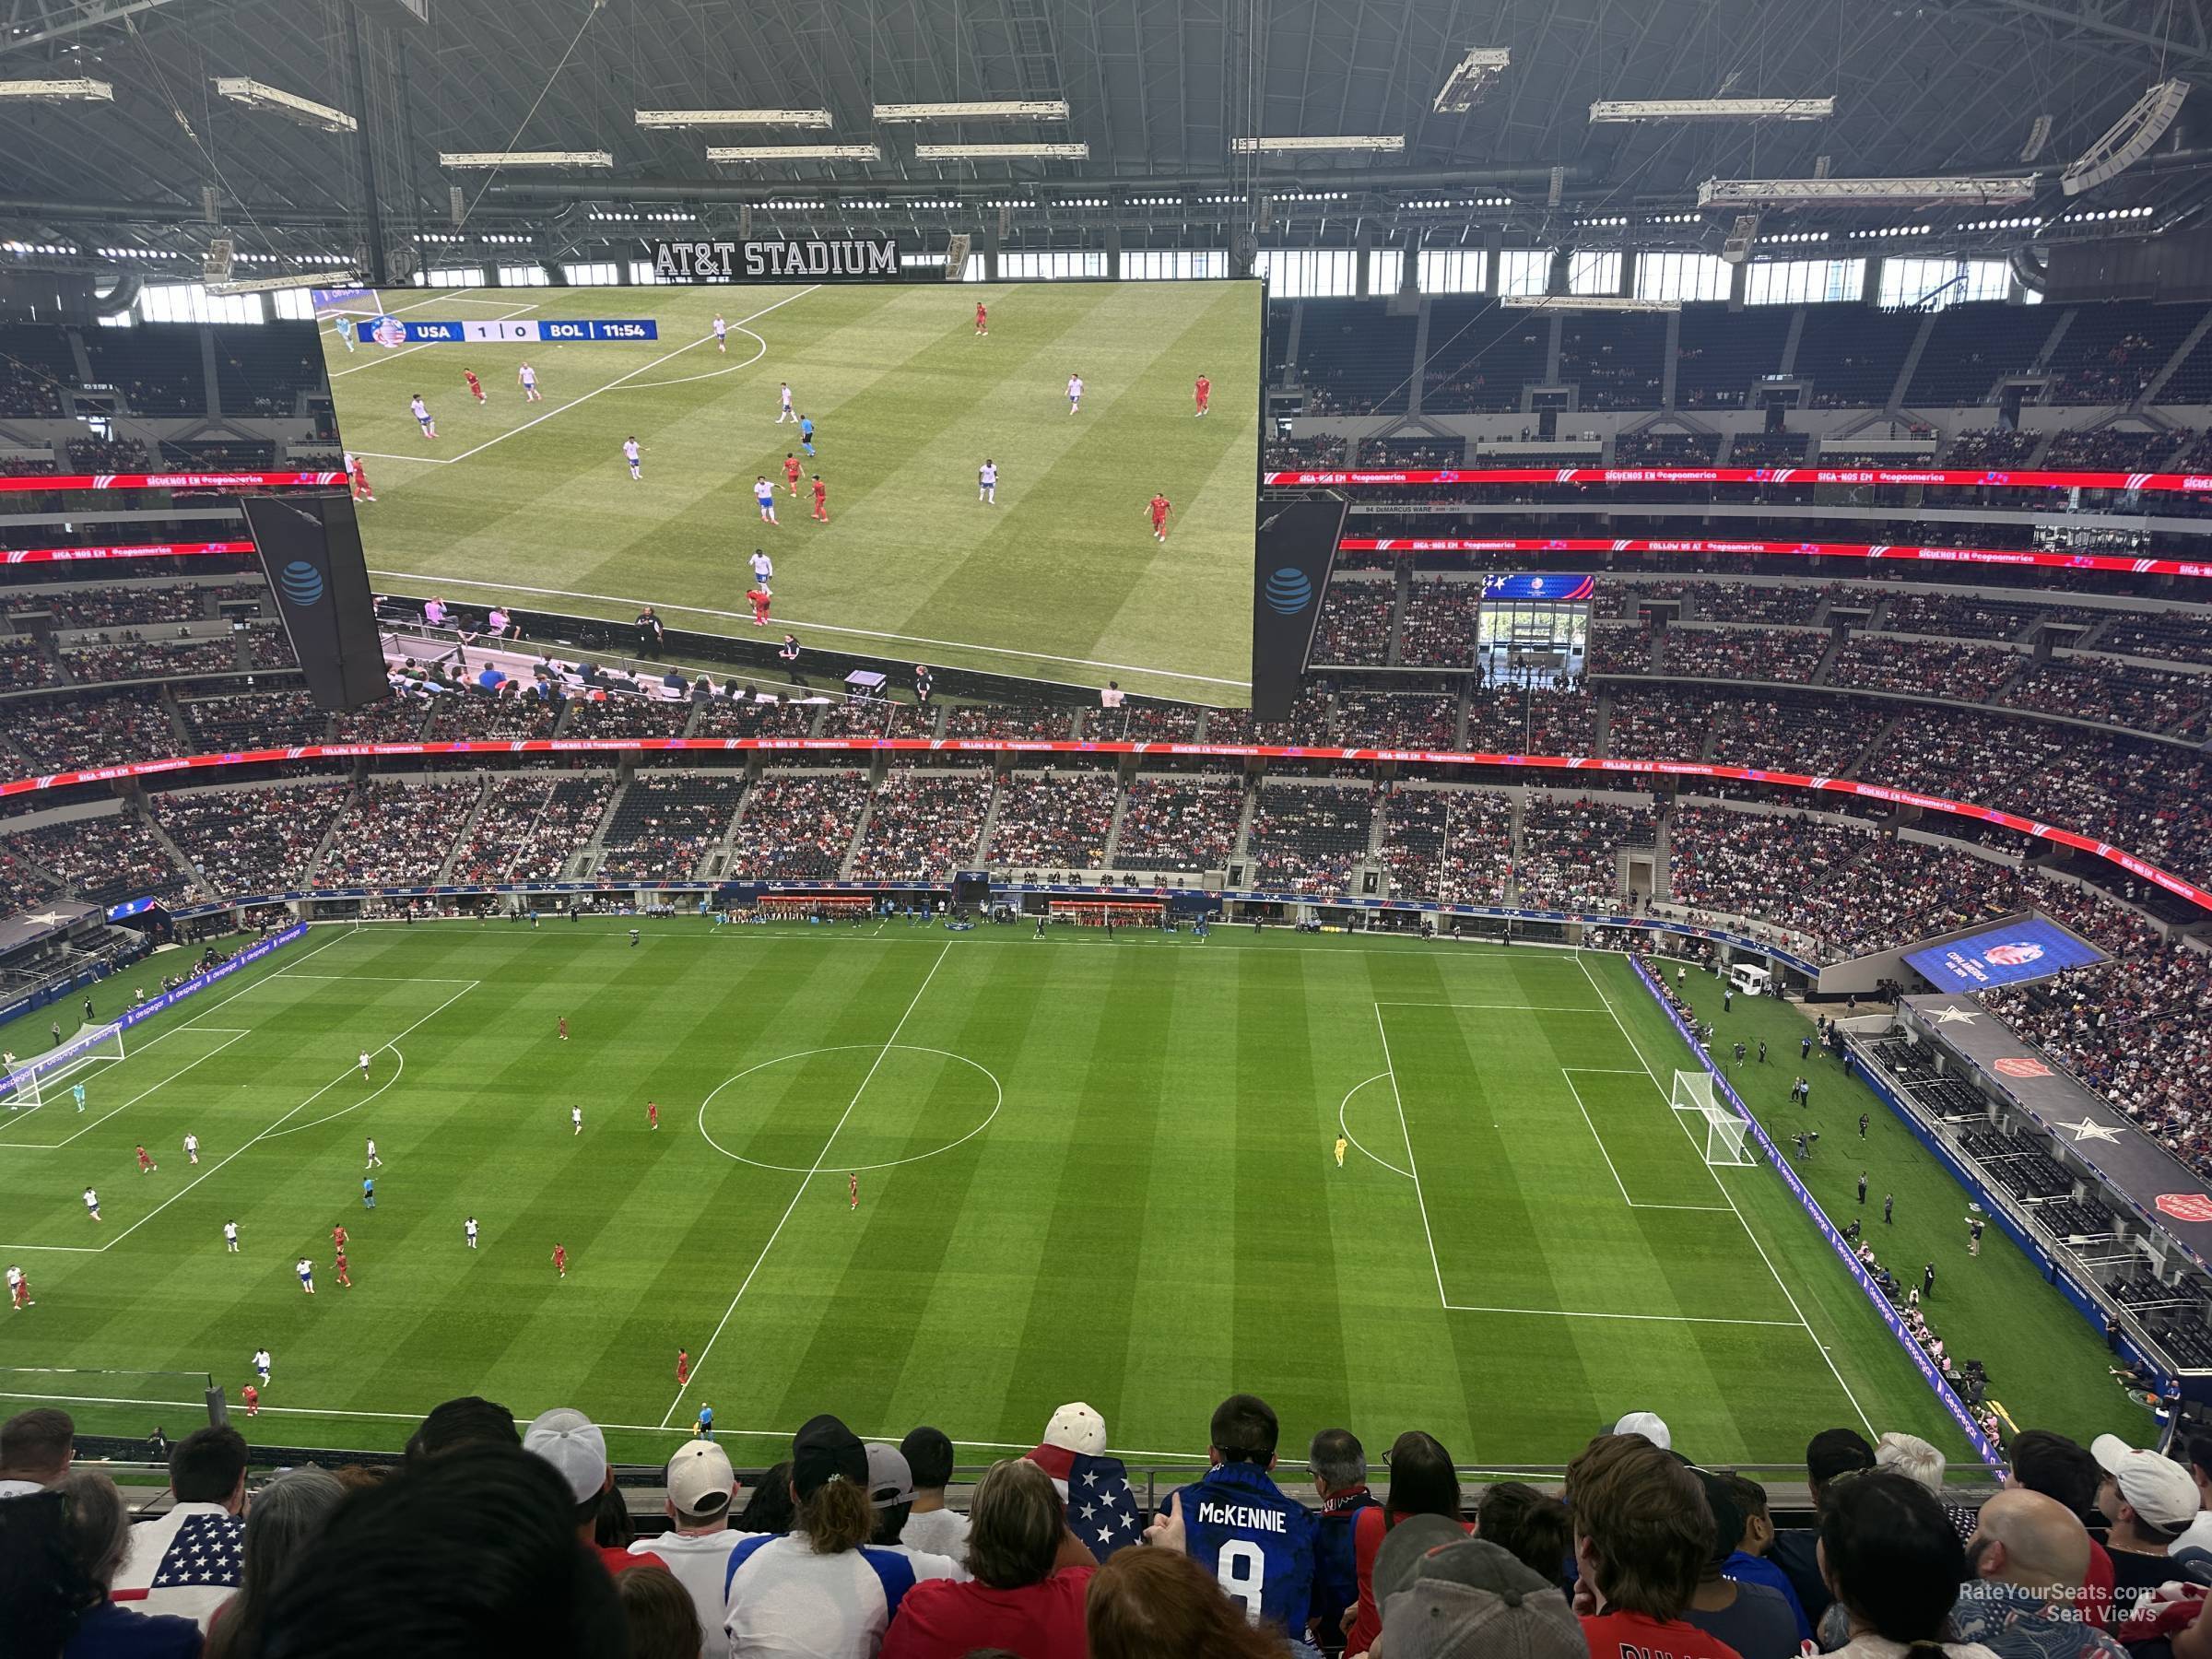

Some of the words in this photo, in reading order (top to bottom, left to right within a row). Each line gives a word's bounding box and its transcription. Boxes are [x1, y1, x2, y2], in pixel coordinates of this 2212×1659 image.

[655, 240, 735, 275] AT&T
[746, 239, 898, 276] STADIUM
[417, 325, 451, 339] USA
[478, 326, 487, 338] 1
[515, 326, 526, 339] 0
[550, 325, 584, 338] BOL
[603, 324, 646, 338] 11:54
[1335, 474, 1346, 482] EM
[1645, 471, 1655, 479] EN
[1860, 473, 1873, 481] EM
[175, 980, 202, 998] despegar
[135, 999, 164, 1018] despegar
[1837, 1242, 1860, 1276] despegar
[1869, 1287, 1895, 1324] despegar
[1904, 1336, 1933, 1378] despegar
[1945, 1393, 1977, 1440] despegar
[1198, 1502, 1287, 1534] McKENNIE
